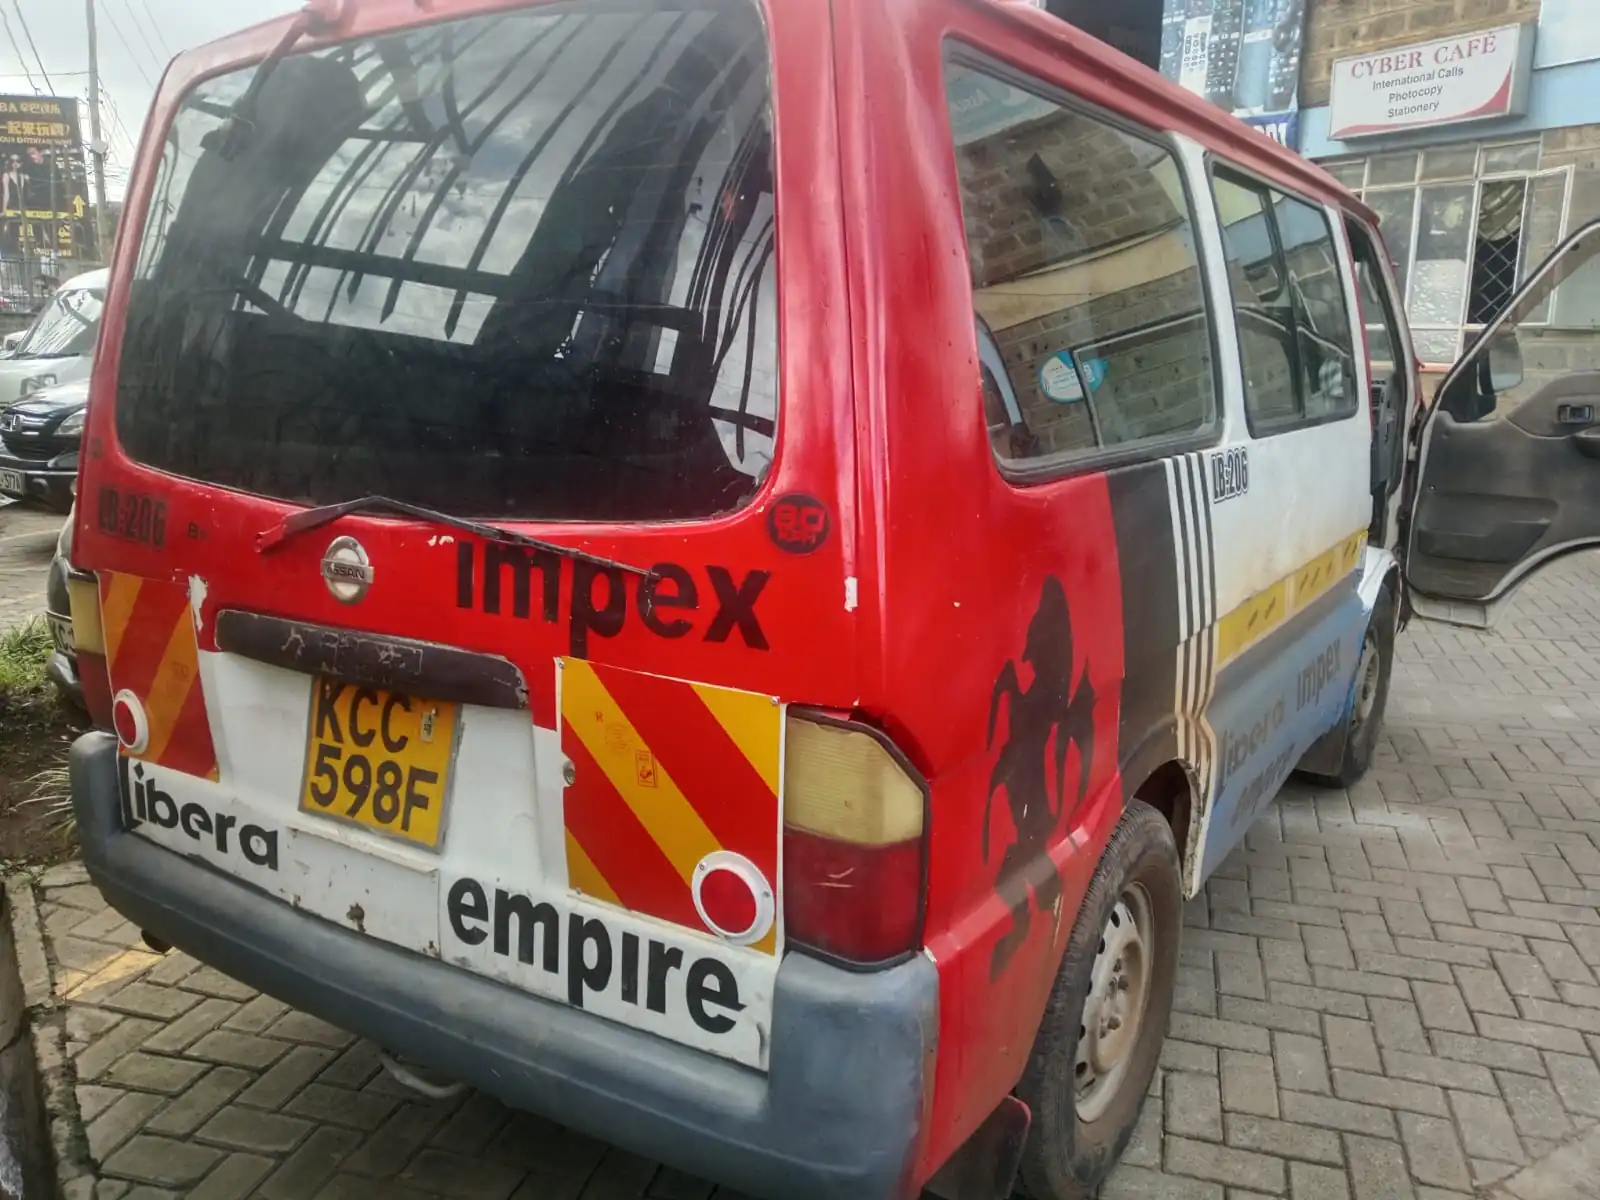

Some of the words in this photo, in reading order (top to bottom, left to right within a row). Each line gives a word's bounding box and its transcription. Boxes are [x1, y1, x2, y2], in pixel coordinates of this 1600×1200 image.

[1351, 50, 1423, 78] CYBER
[1433, 32, 1496, 64] CAFÉ
[1372, 71, 1435, 91] International
[1437, 66, 1464, 80] Calls
[1388, 84, 1443, 103] Photocopy
[1387, 101, 1440, 118] Stationery
[1211, 447, 1248, 503] LB:206
[315, 674, 413, 753] KCC
[310, 744, 438, 832] 598F
